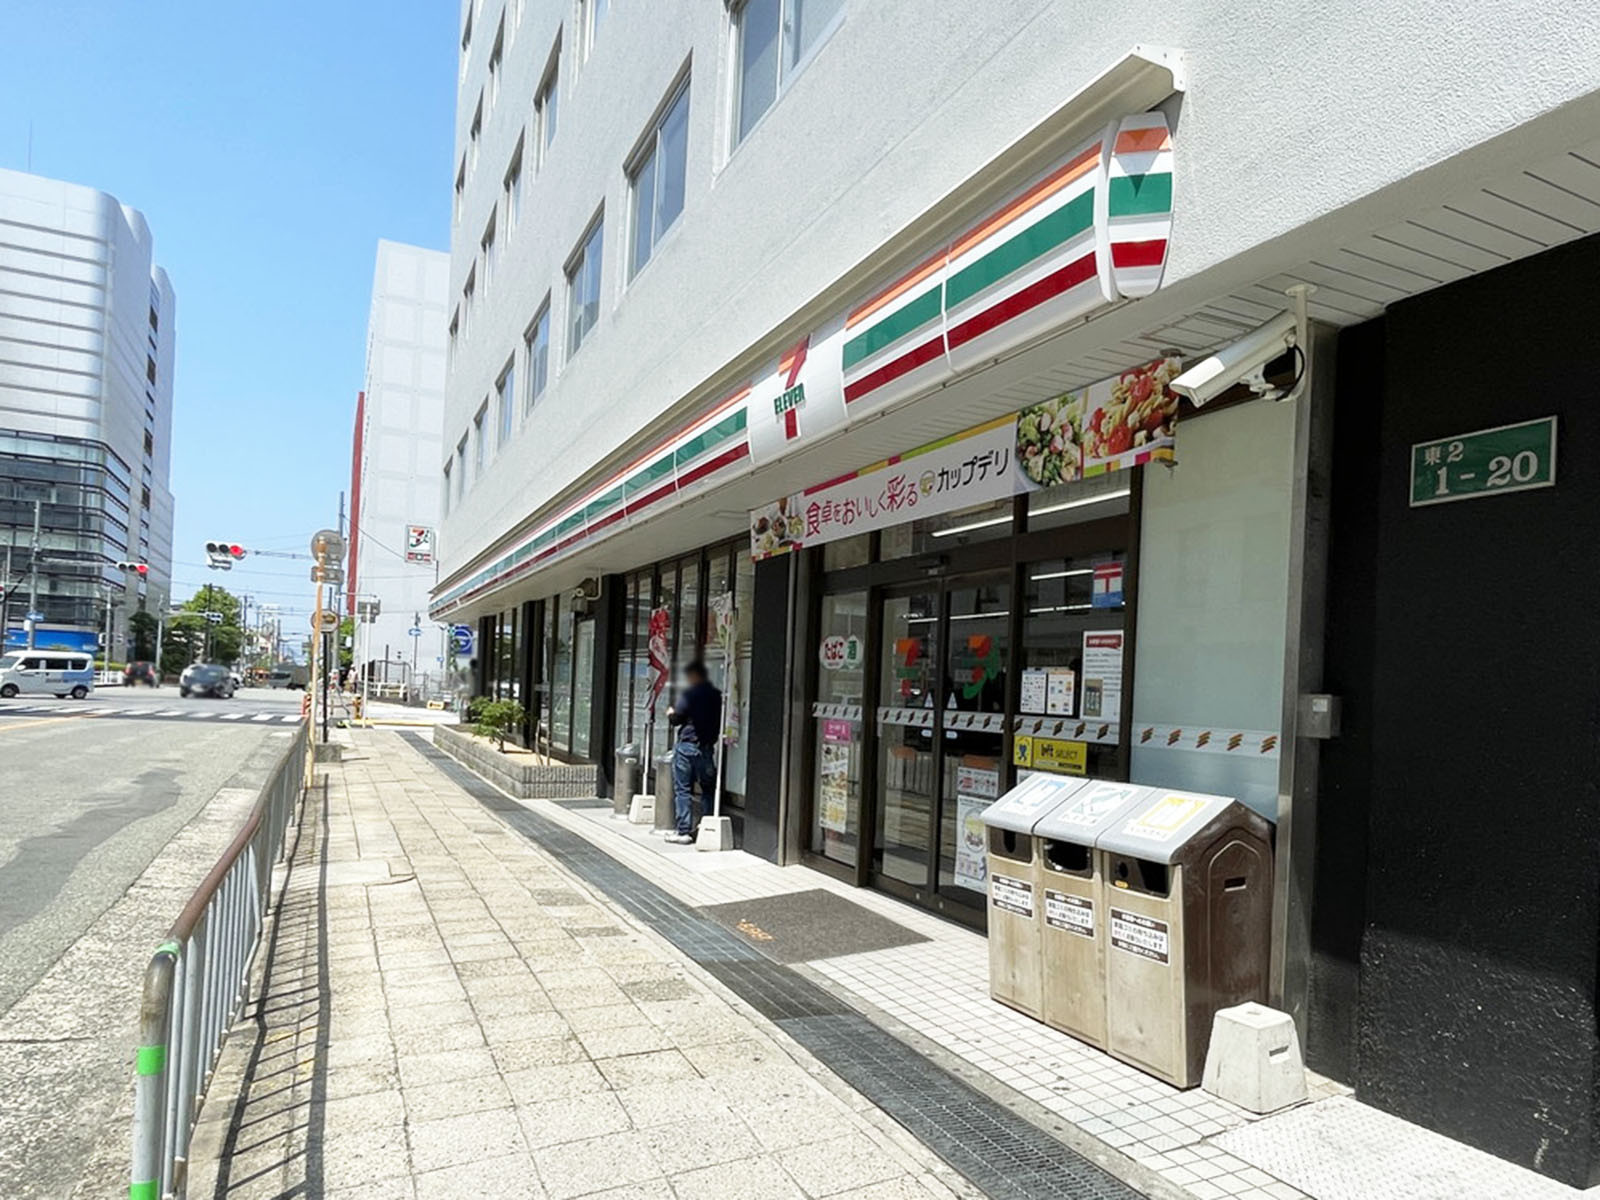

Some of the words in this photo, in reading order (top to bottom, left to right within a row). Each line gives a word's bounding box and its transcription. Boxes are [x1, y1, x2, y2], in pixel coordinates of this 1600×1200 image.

[805, 474, 919, 538] 食卓をおいしく彩る
[936, 448, 1010, 493] カップデリ
